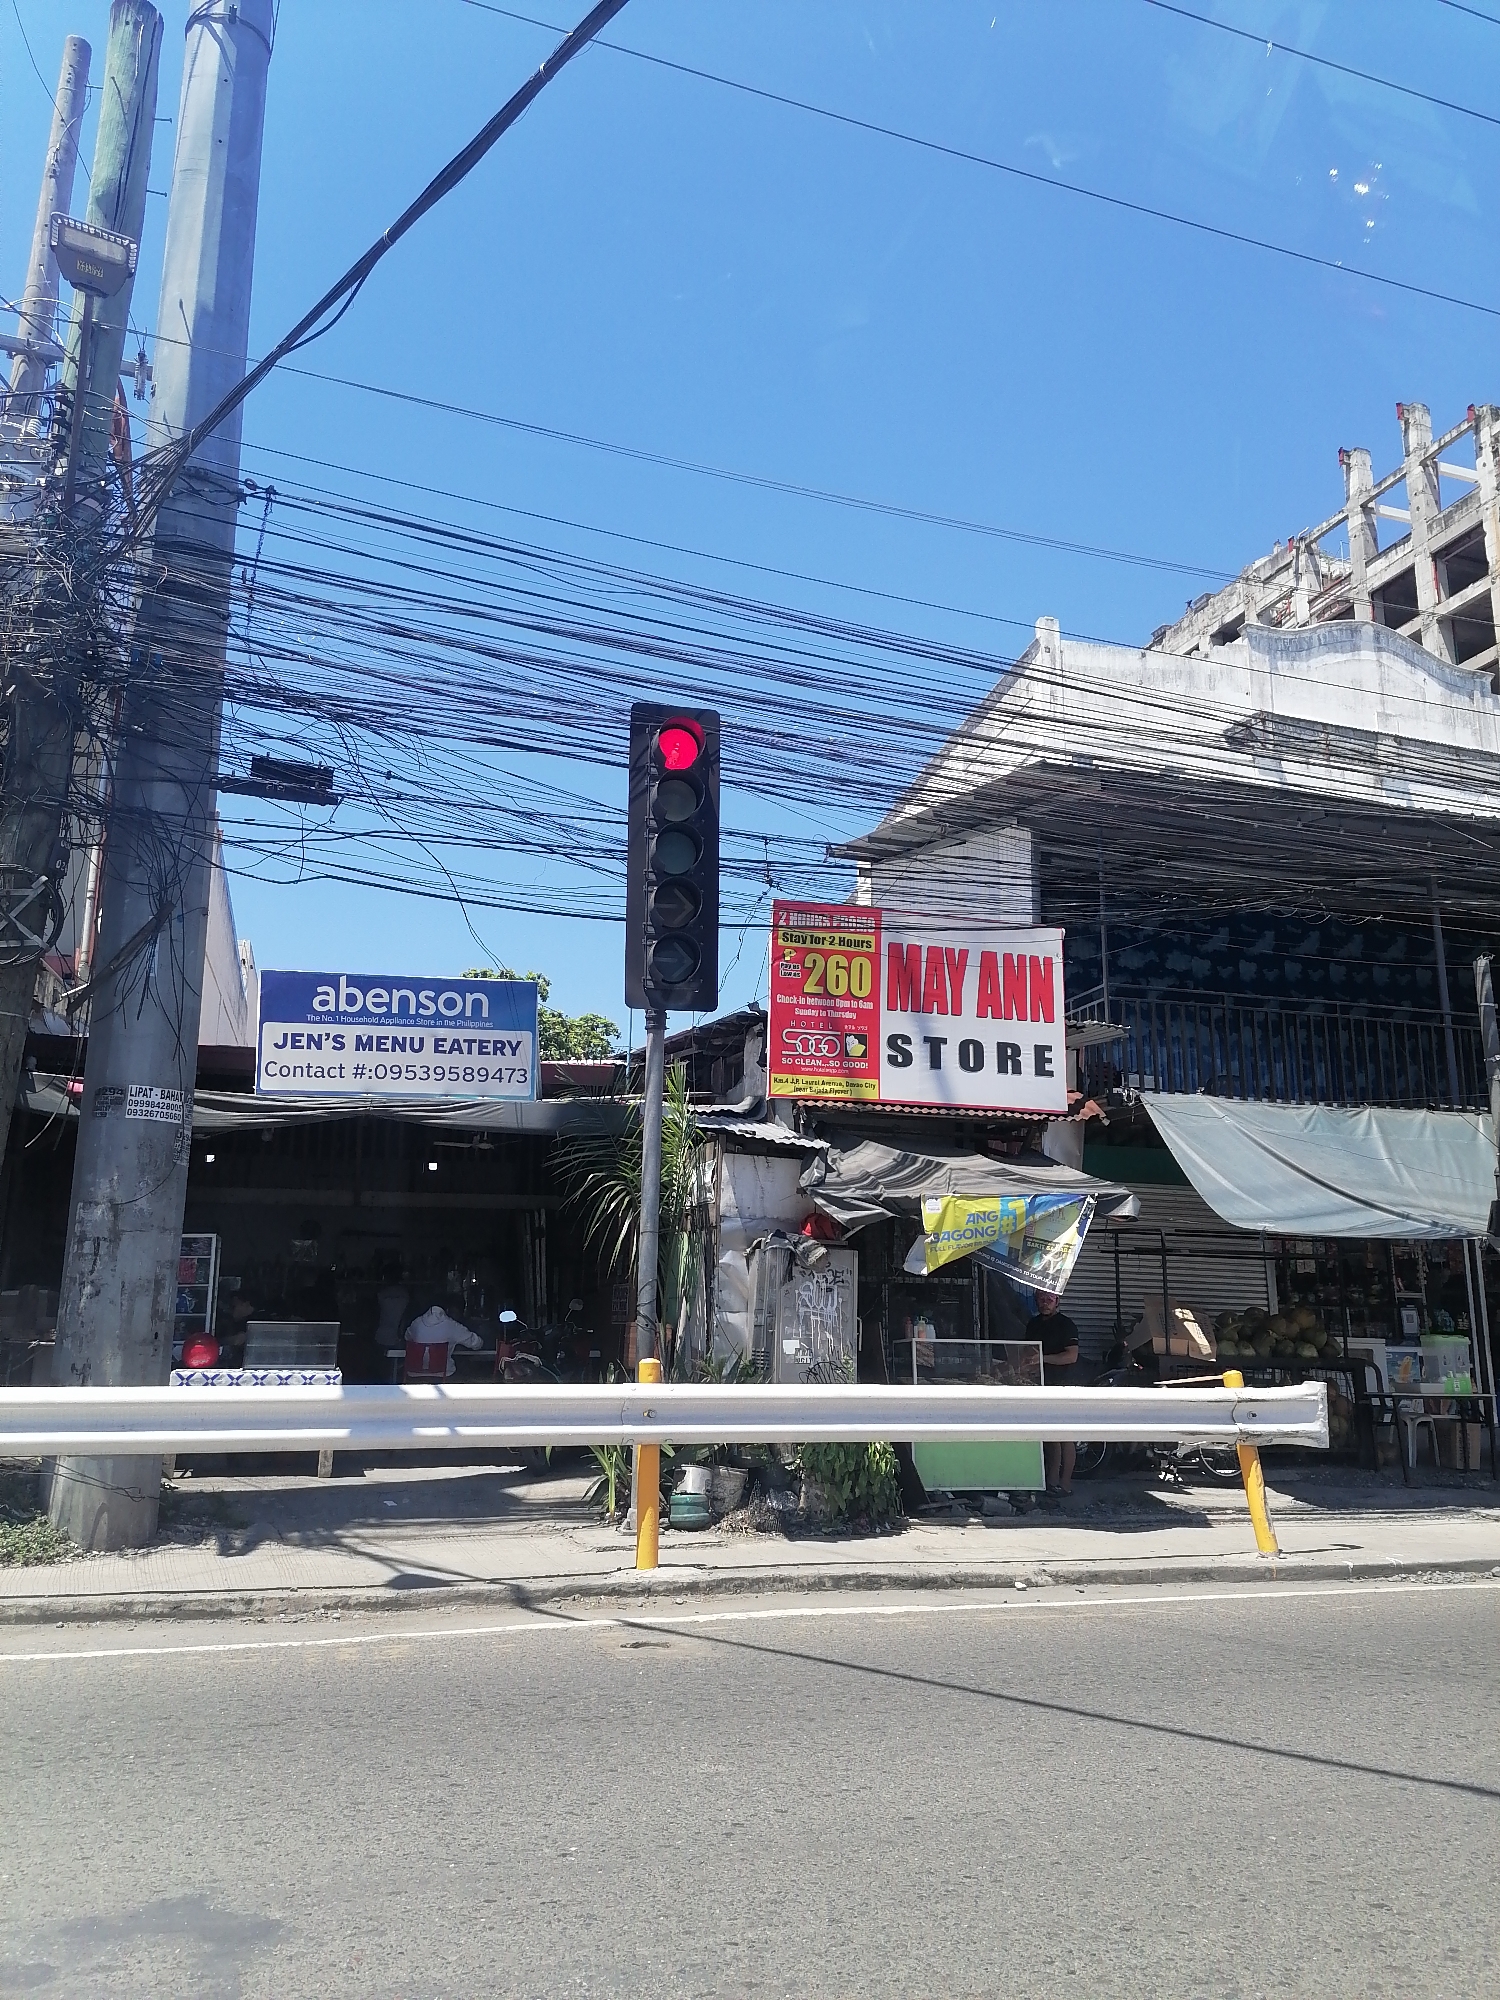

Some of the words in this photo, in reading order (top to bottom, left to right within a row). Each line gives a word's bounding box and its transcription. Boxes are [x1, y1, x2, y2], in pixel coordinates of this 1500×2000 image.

[782, 932, 807, 945] Stay
[809, 934, 826, 945] for
[829, 936, 836, 945] 2
[838, 936, 872, 949] Hours
[803, 952, 872, 998] 260
[887, 942, 969, 1016] MAY
[976, 951, 1055, 1023] ANN
[312, 975, 489, 1018] abenson
[851, 999, 858, 1008] to
[306, 1014, 321, 1022] The
[340, 1015, 379, 1024] Household
[380, 1016, 415, 1026] Appliance
[416, 1017, 435, 1026] Store
[436, 1018, 443, 1026] in
[444, 1018, 456, 1026] the
[456, 1019, 494, 1029] Philippines
[795, 1008, 819, 1018] Sunday
[819, 1009, 827, 1017] to
[827, 1009, 857, 1020] Thursday
[790, 1020, 833, 1030] HOTEL
[273, 1032, 346, 1051] JEN'S
[354, 1034, 425, 1054] MENU
[433, 1037, 523, 1057] EATERY
[781, 1028, 841, 1057] SOGO
[781, 1057, 793, 1065] SO
[842, 1061, 869, 1069] GOOD!
[886, 1033, 1055, 1078] STORE
[264, 1060, 346, 1079] Contact
[129, 1086, 153, 1099] LIPAT
[160, 1089, 184, 1102] BAHAY
[864, 1082, 876, 1090] City
[965, 1210, 998, 1225] ANG
